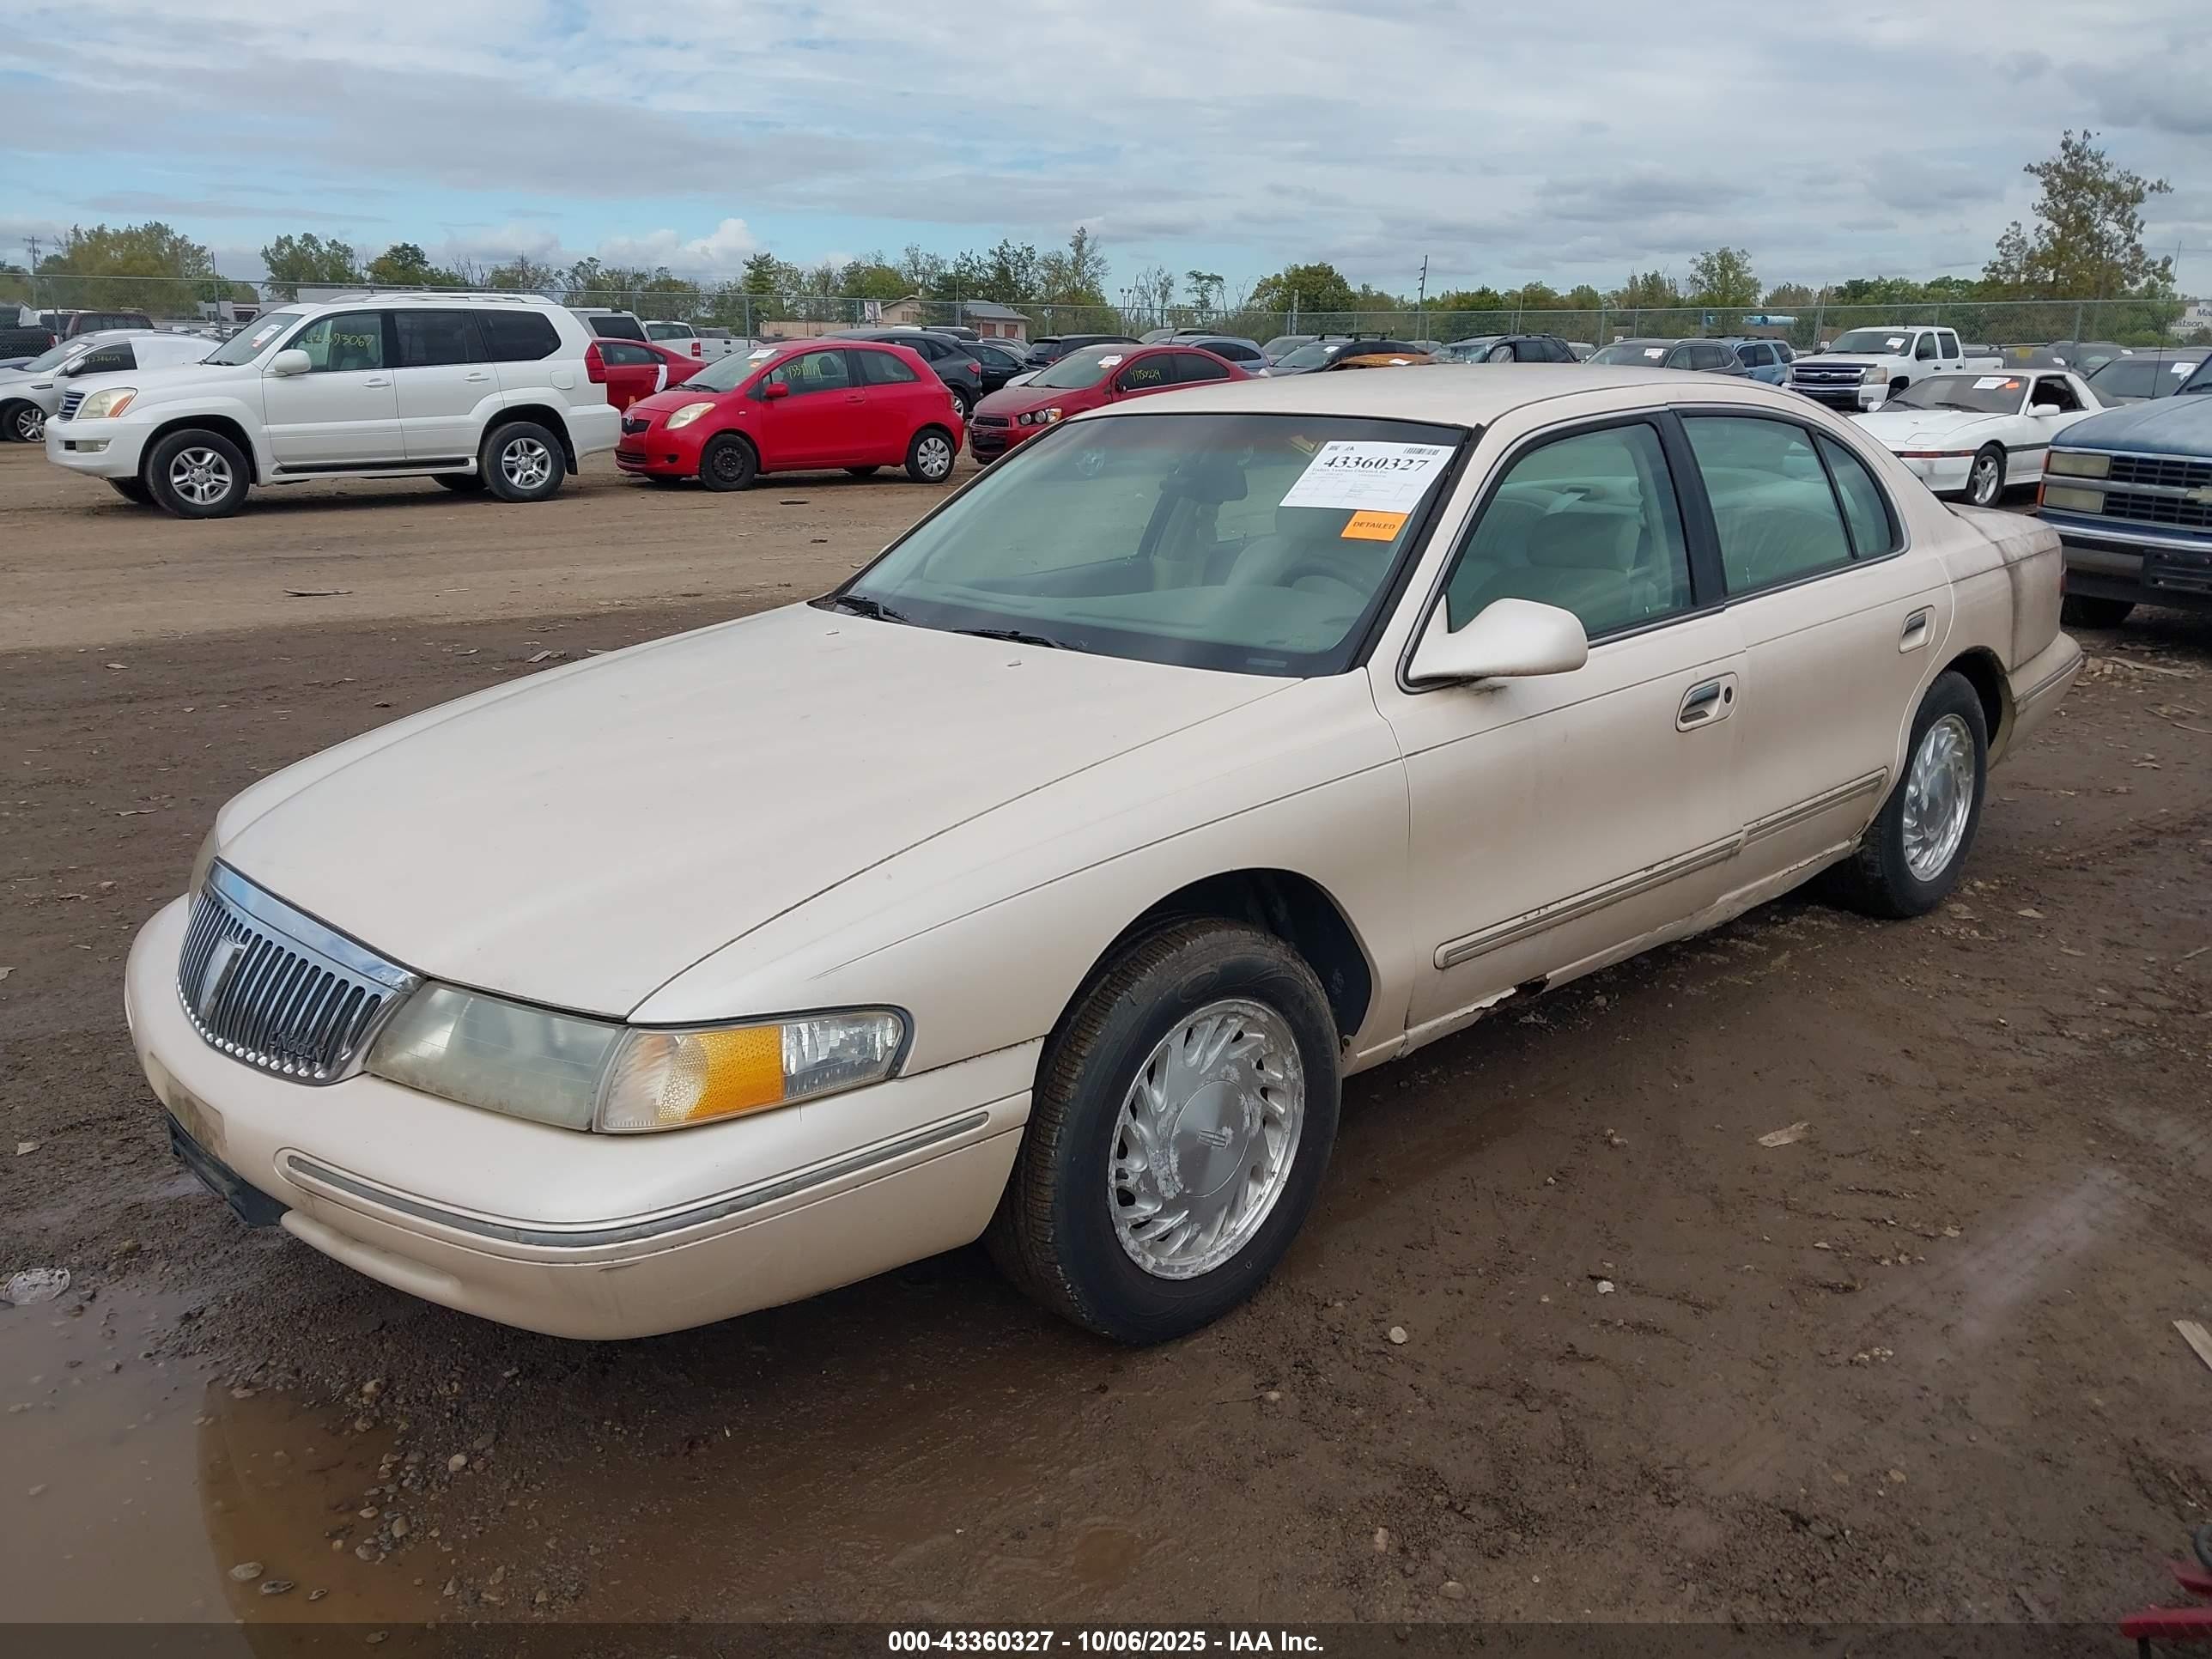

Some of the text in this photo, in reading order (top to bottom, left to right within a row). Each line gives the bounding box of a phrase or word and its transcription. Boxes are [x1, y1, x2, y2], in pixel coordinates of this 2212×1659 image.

[1324, 456, 1430, 471] 43360327
[1352, 520, 1397, 530] DETAILED
[270, 1031, 327, 1063] LINCOLN
